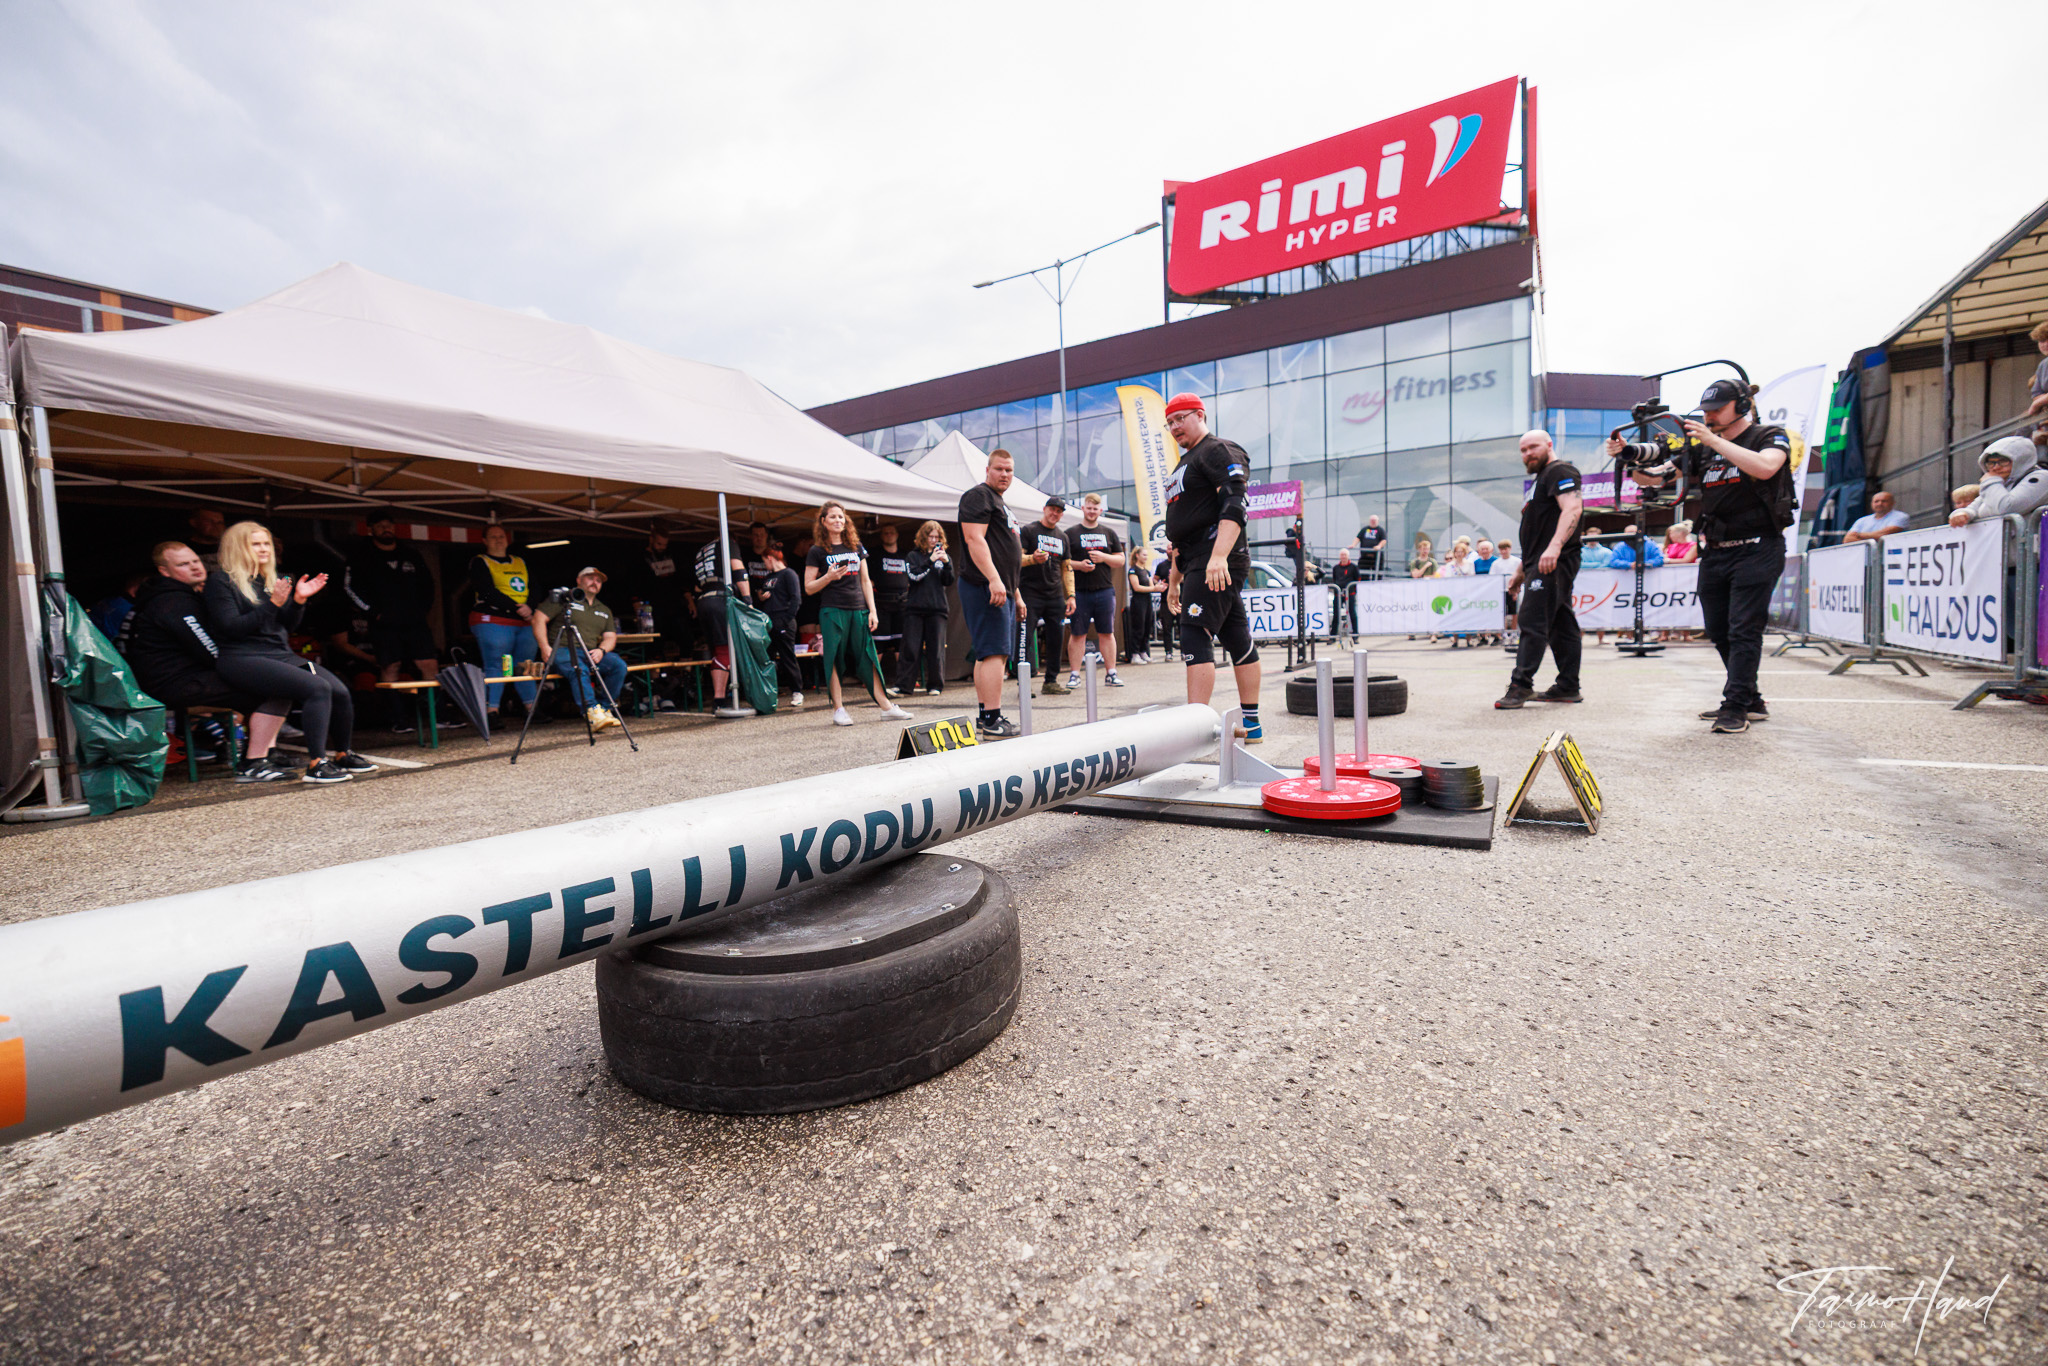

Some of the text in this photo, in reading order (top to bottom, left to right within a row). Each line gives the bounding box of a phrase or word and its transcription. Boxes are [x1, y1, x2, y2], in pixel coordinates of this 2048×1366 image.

[1285, 206, 1398, 253] HYPER
[1342, 369, 1497, 424] myfitness
[1907, 541, 1966, 586] EESTI
[1362, 601, 1424, 614] Woodwell
[1819, 585, 1864, 614] KASTELLI
[1908, 594, 1998, 644] HALDUS
[119, 744, 1137, 1093] KASTELLI KODU. MIS KESTAB!
